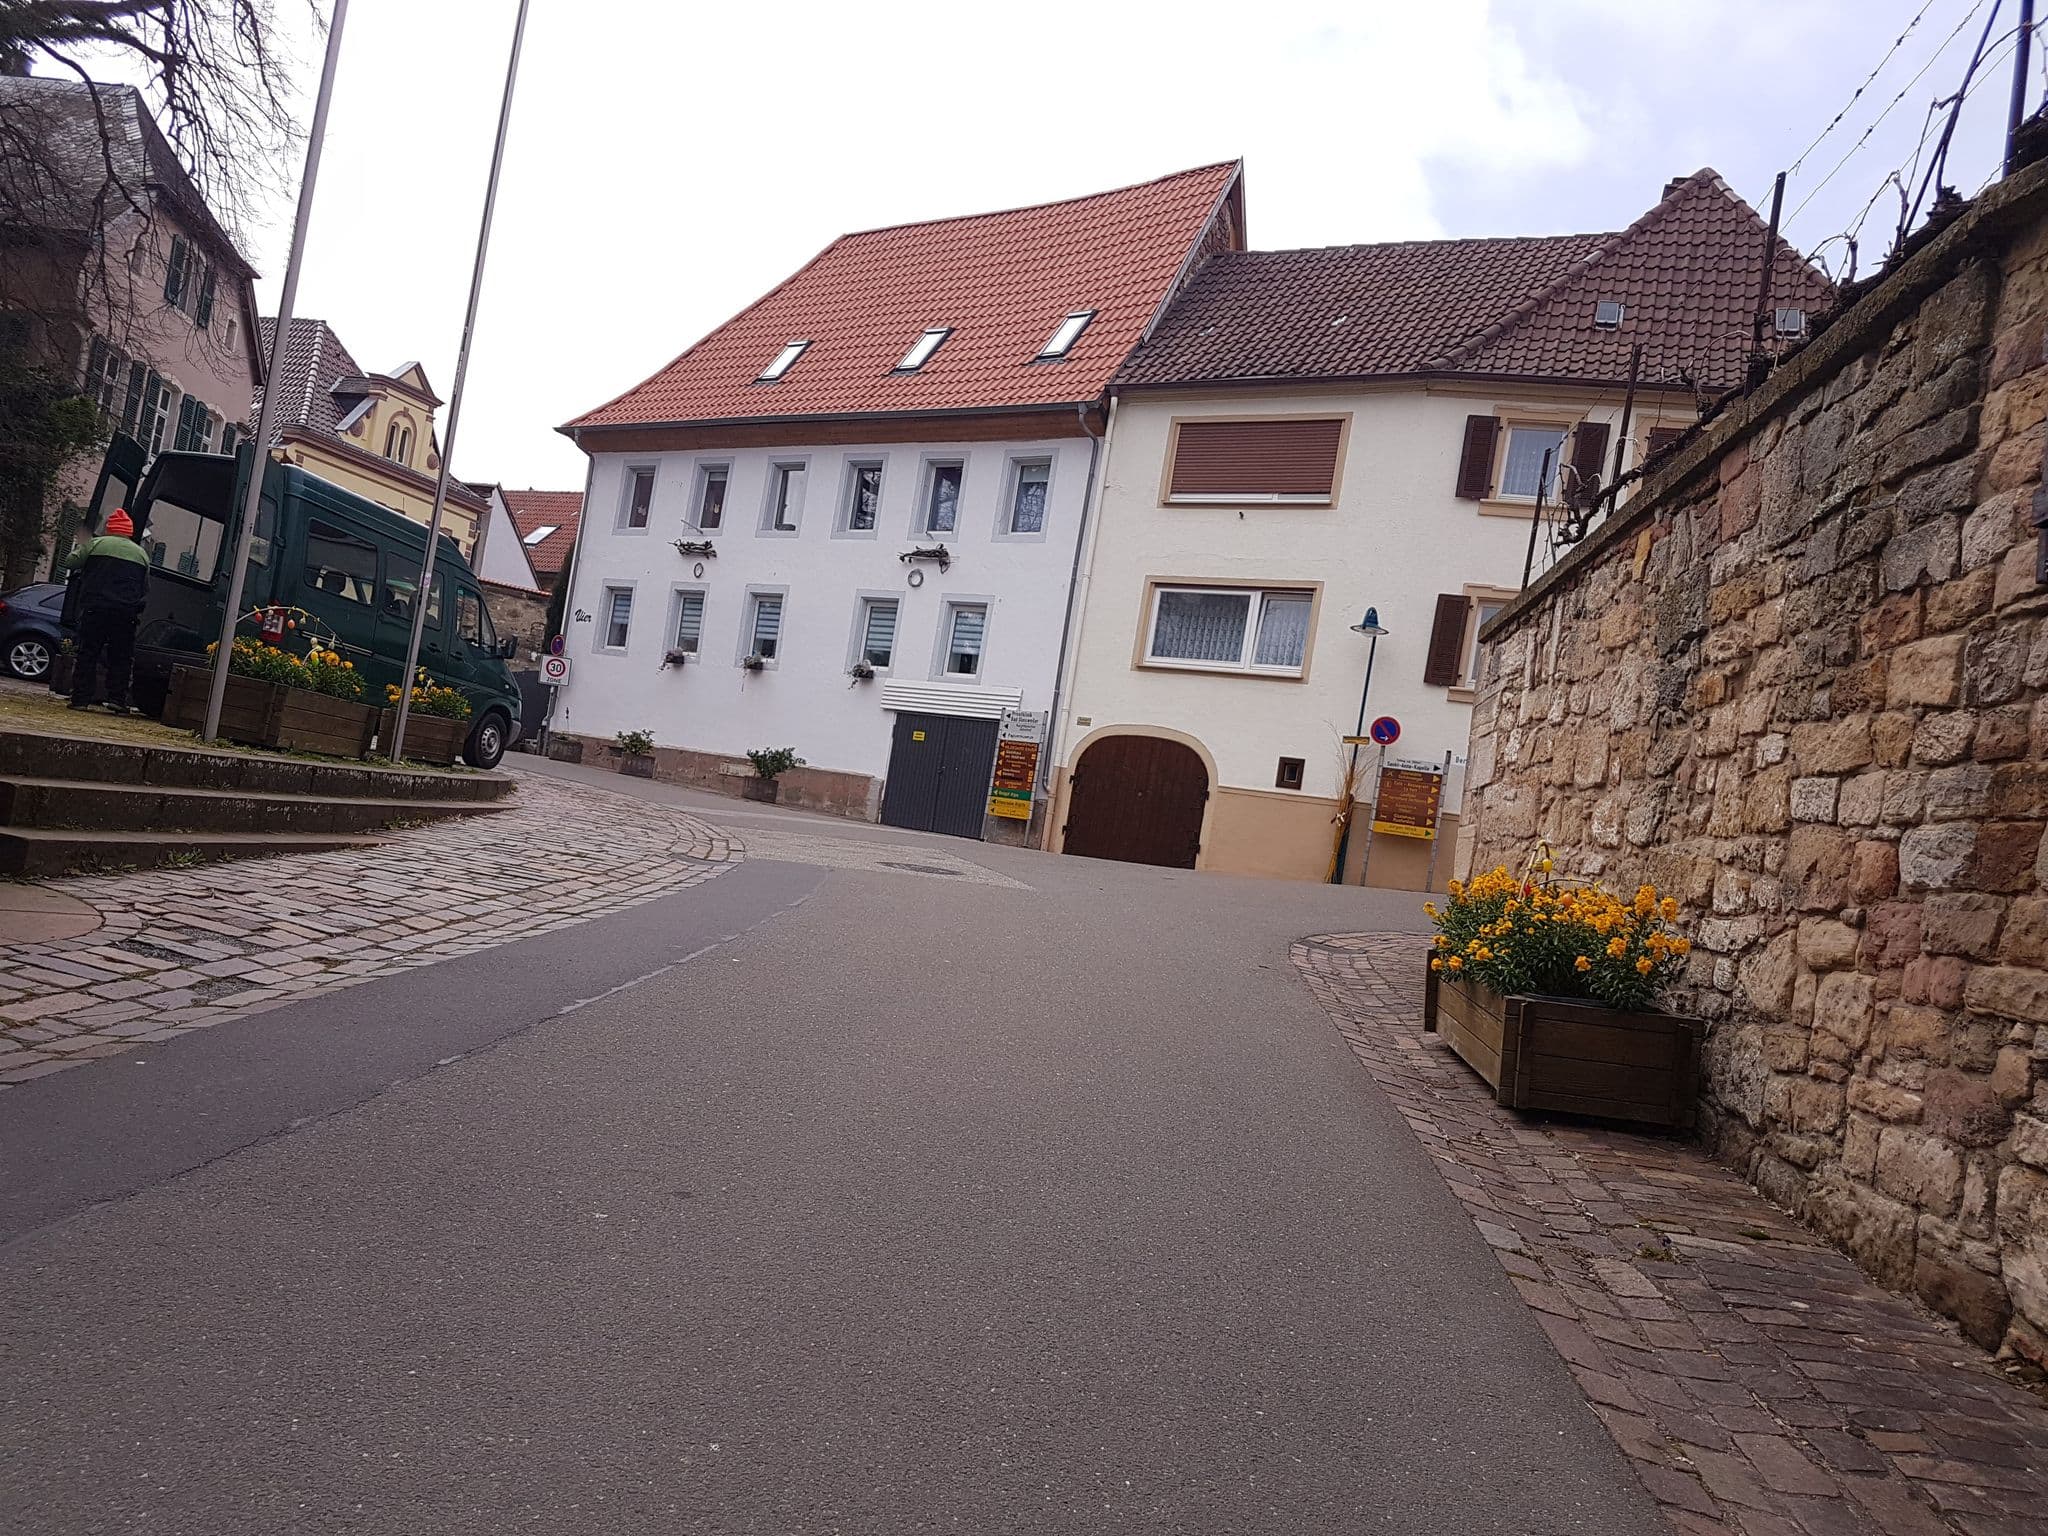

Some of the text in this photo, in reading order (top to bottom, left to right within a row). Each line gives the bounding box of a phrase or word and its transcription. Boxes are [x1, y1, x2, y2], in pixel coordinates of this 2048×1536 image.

[575, 608, 591, 622] Vier
[550, 663, 562, 673] 30
[547, 676, 561, 684] ZONE
